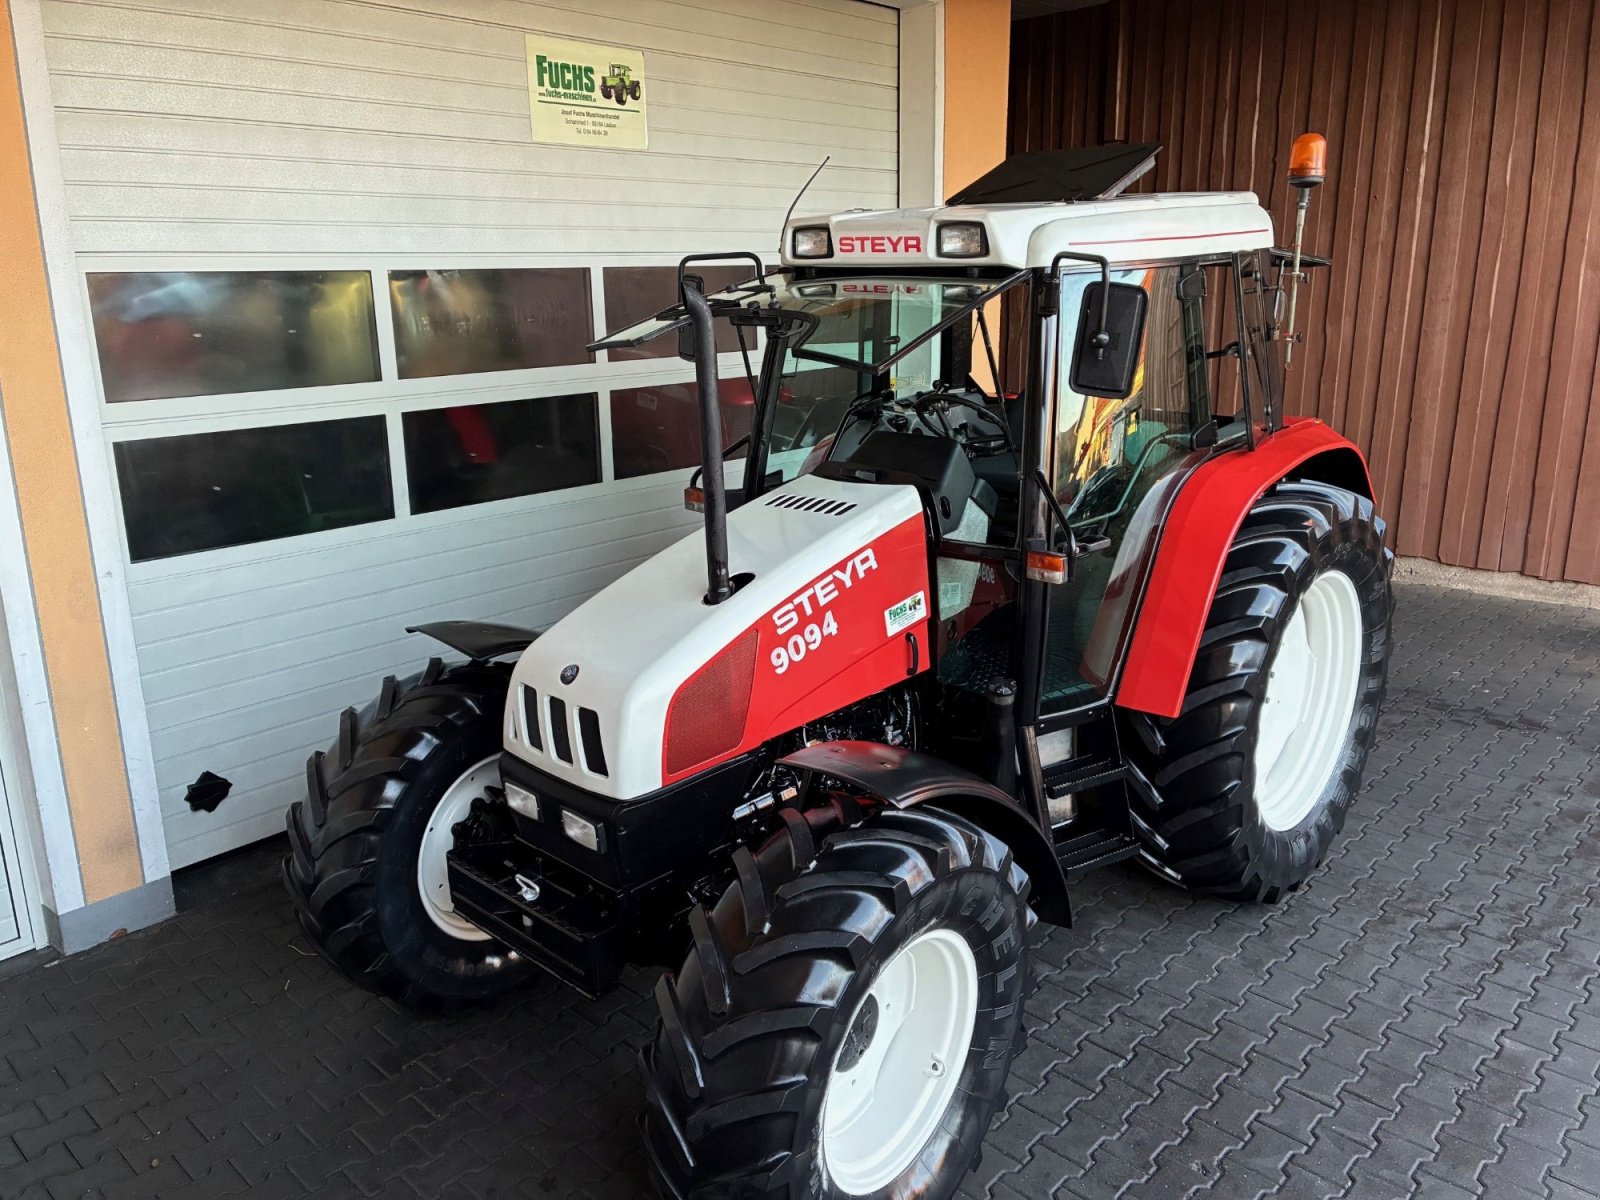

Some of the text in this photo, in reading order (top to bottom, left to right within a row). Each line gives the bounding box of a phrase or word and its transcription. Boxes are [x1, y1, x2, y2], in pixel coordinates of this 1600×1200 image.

[536, 55, 596, 93] FUCHS
[839, 235, 922, 253] STEYR
[772, 547, 878, 635] STEYR
[889, 603, 907, 620] FUCHS
[770, 609, 838, 675] 9094
